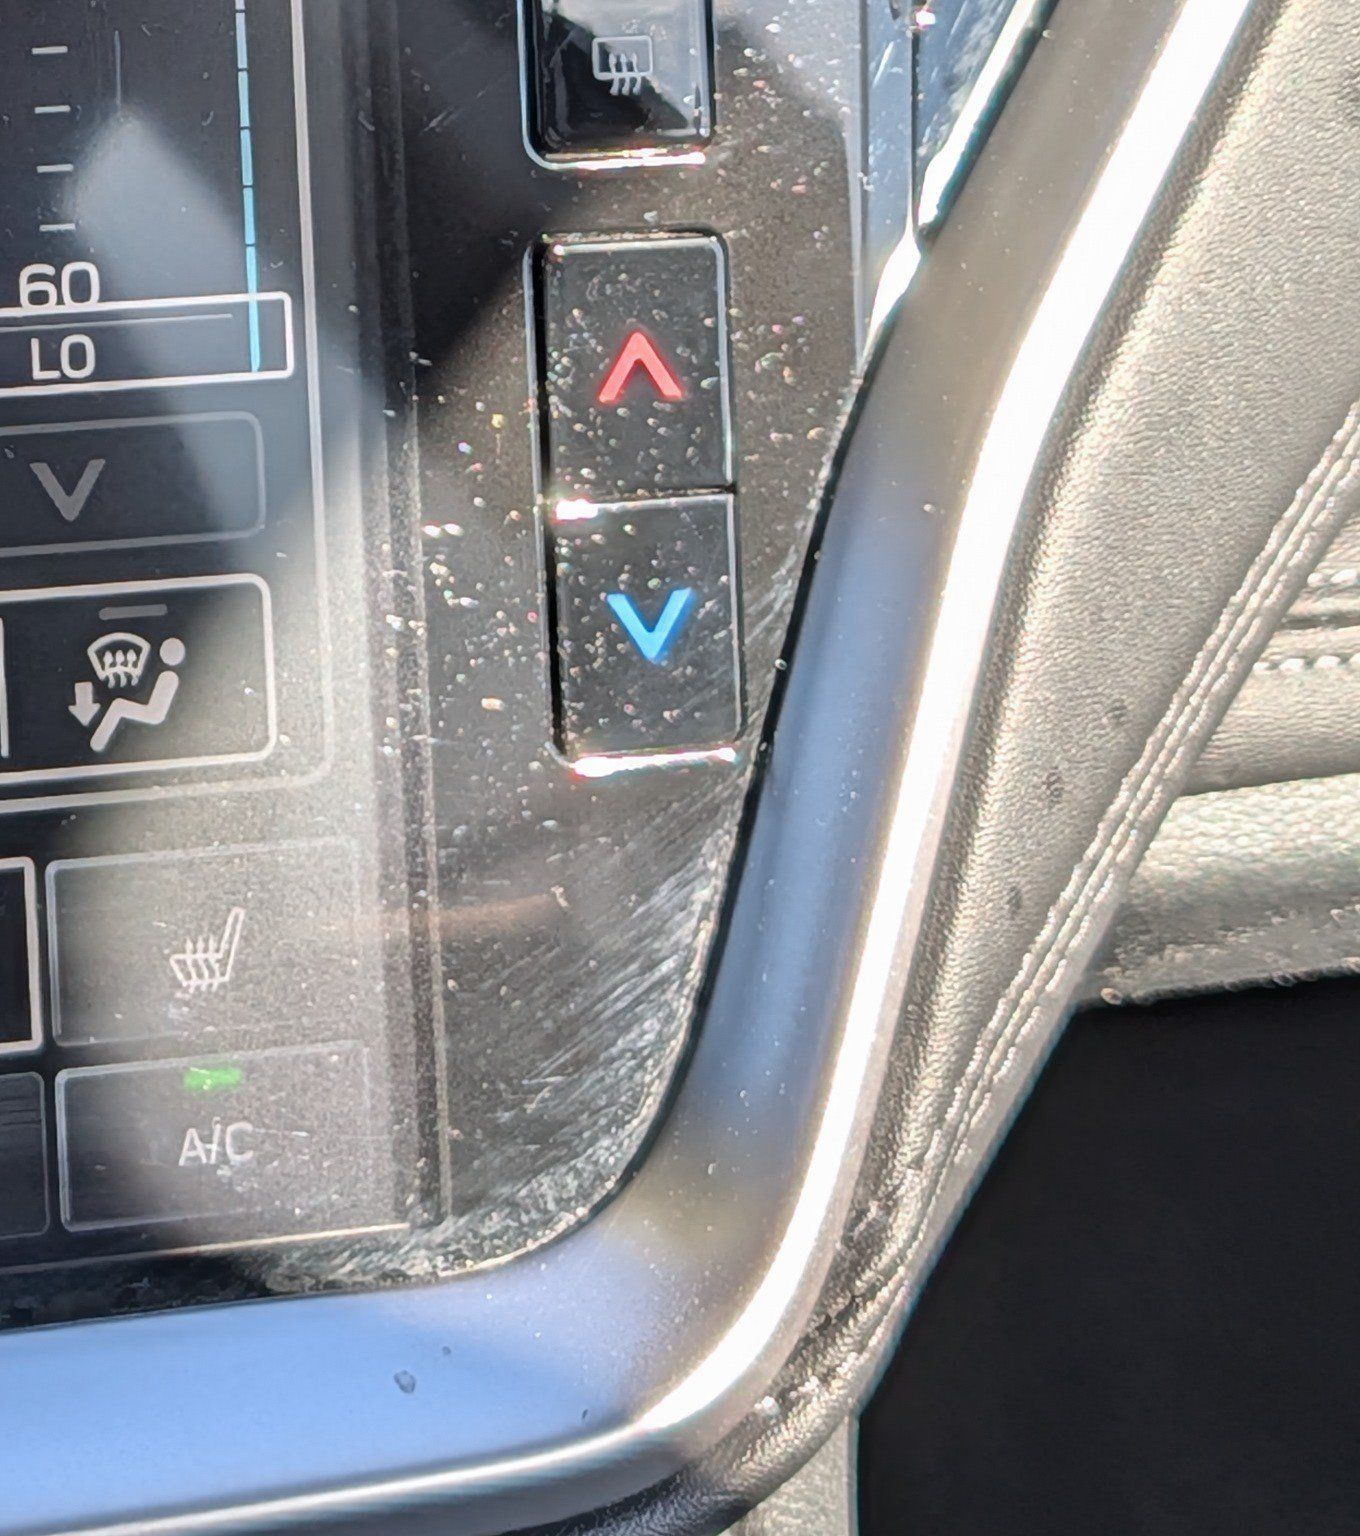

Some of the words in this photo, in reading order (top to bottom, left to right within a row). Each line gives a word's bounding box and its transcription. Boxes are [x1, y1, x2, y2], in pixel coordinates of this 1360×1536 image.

[16, 260, 102, 309] 60
[29, 333, 98, 381] LO
[178, 1116, 255, 1167] A/C
